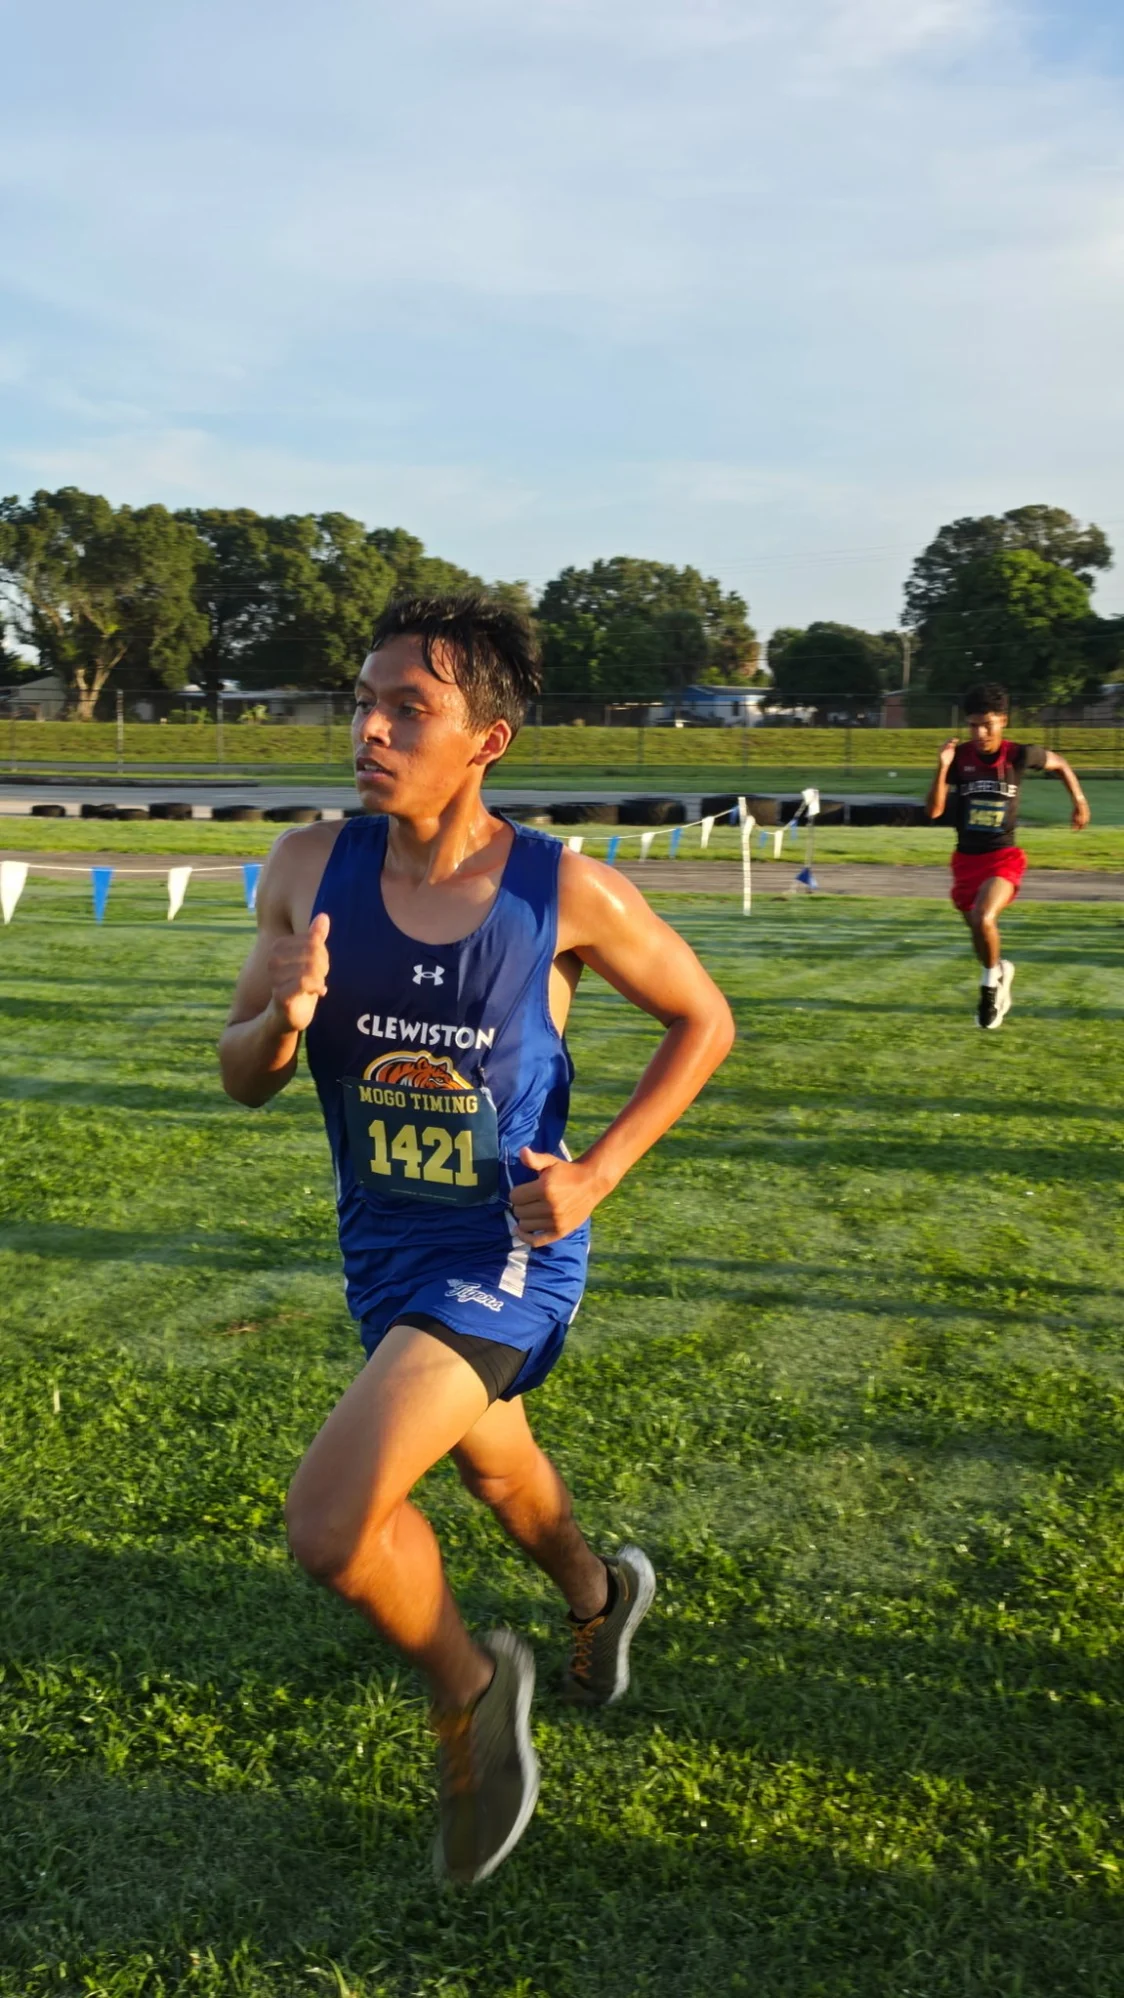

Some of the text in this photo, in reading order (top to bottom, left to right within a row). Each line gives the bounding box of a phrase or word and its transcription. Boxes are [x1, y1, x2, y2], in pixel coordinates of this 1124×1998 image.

[356, 1013, 495, 1050] CLEWISTON
[359, 1085, 479, 1114] MOGO TIMING
[368, 1119, 479, 1187] 1421
[444, 1280, 504, 1313] Tigers
